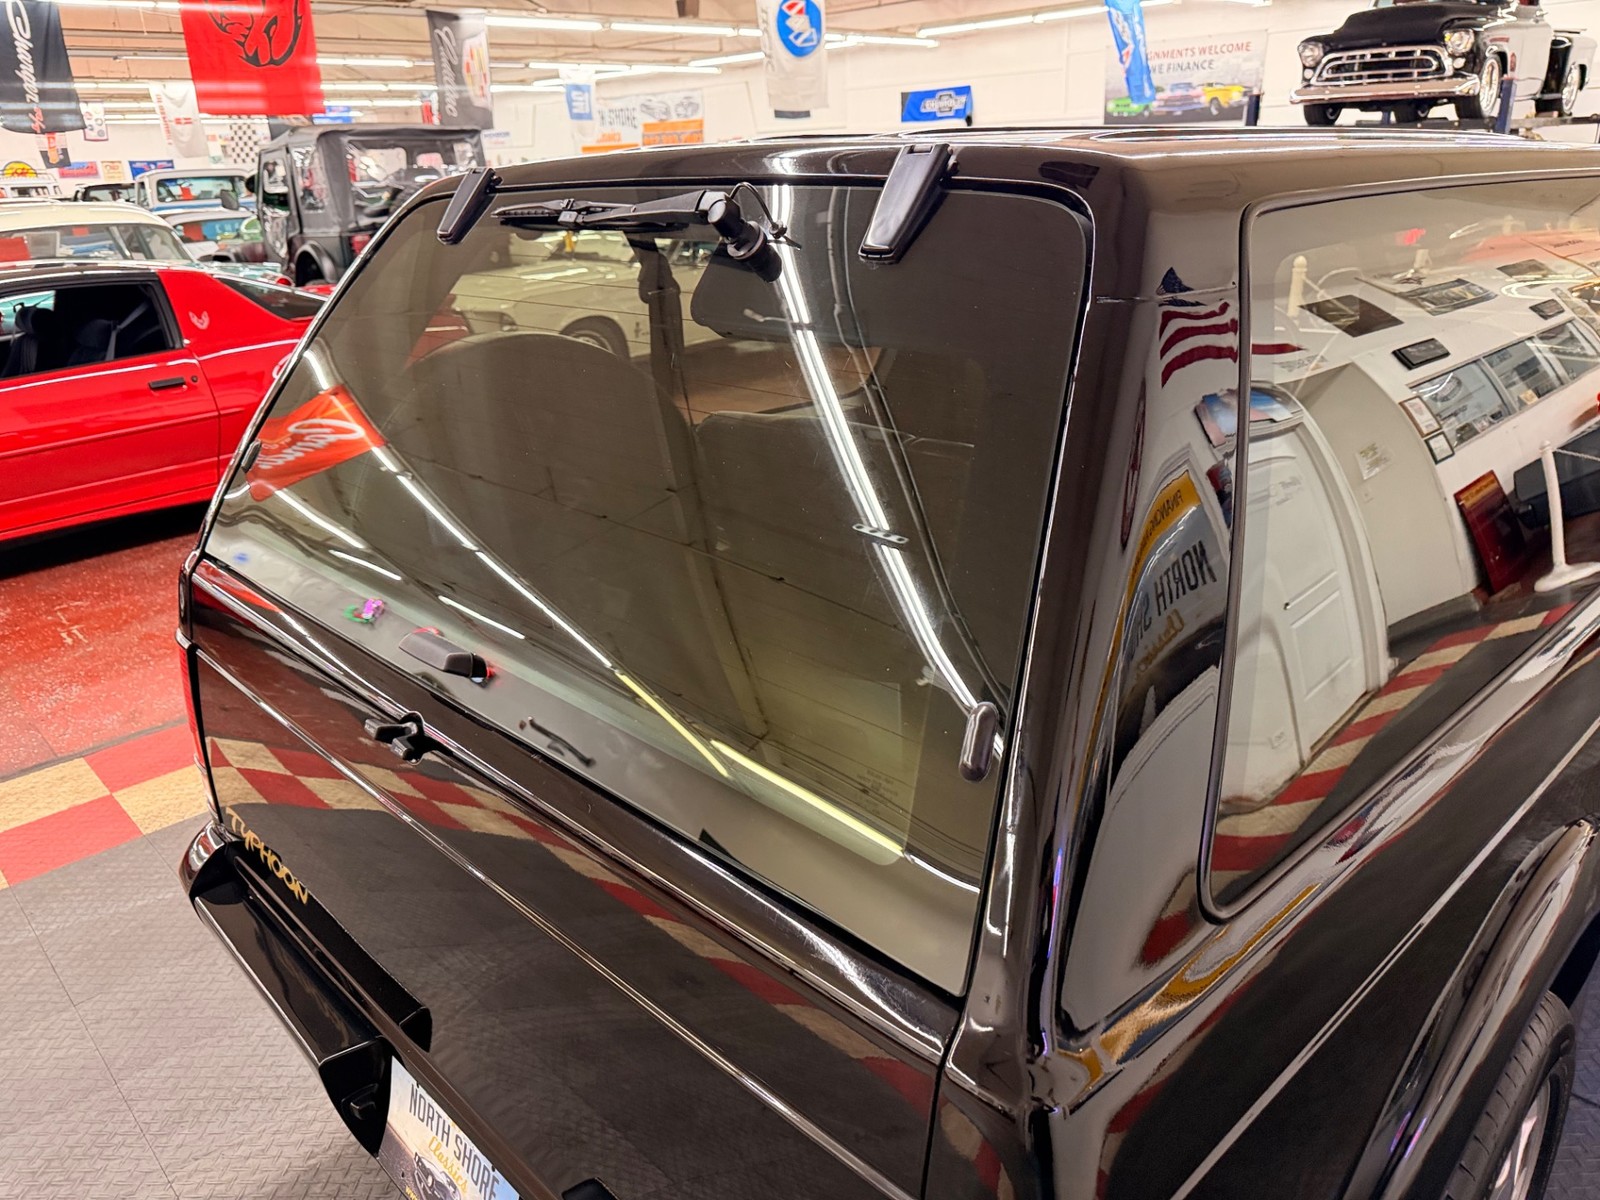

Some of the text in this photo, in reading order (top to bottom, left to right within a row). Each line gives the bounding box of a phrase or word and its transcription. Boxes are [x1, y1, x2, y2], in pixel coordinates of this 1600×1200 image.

[1148, 41, 1252, 61] GNMENTS WELCOME
[1166, 59, 1215, 73] FINANCE
[409, 1083, 500, 1200] NORTH SHORE
[428, 1136, 468, 1194] Classics
